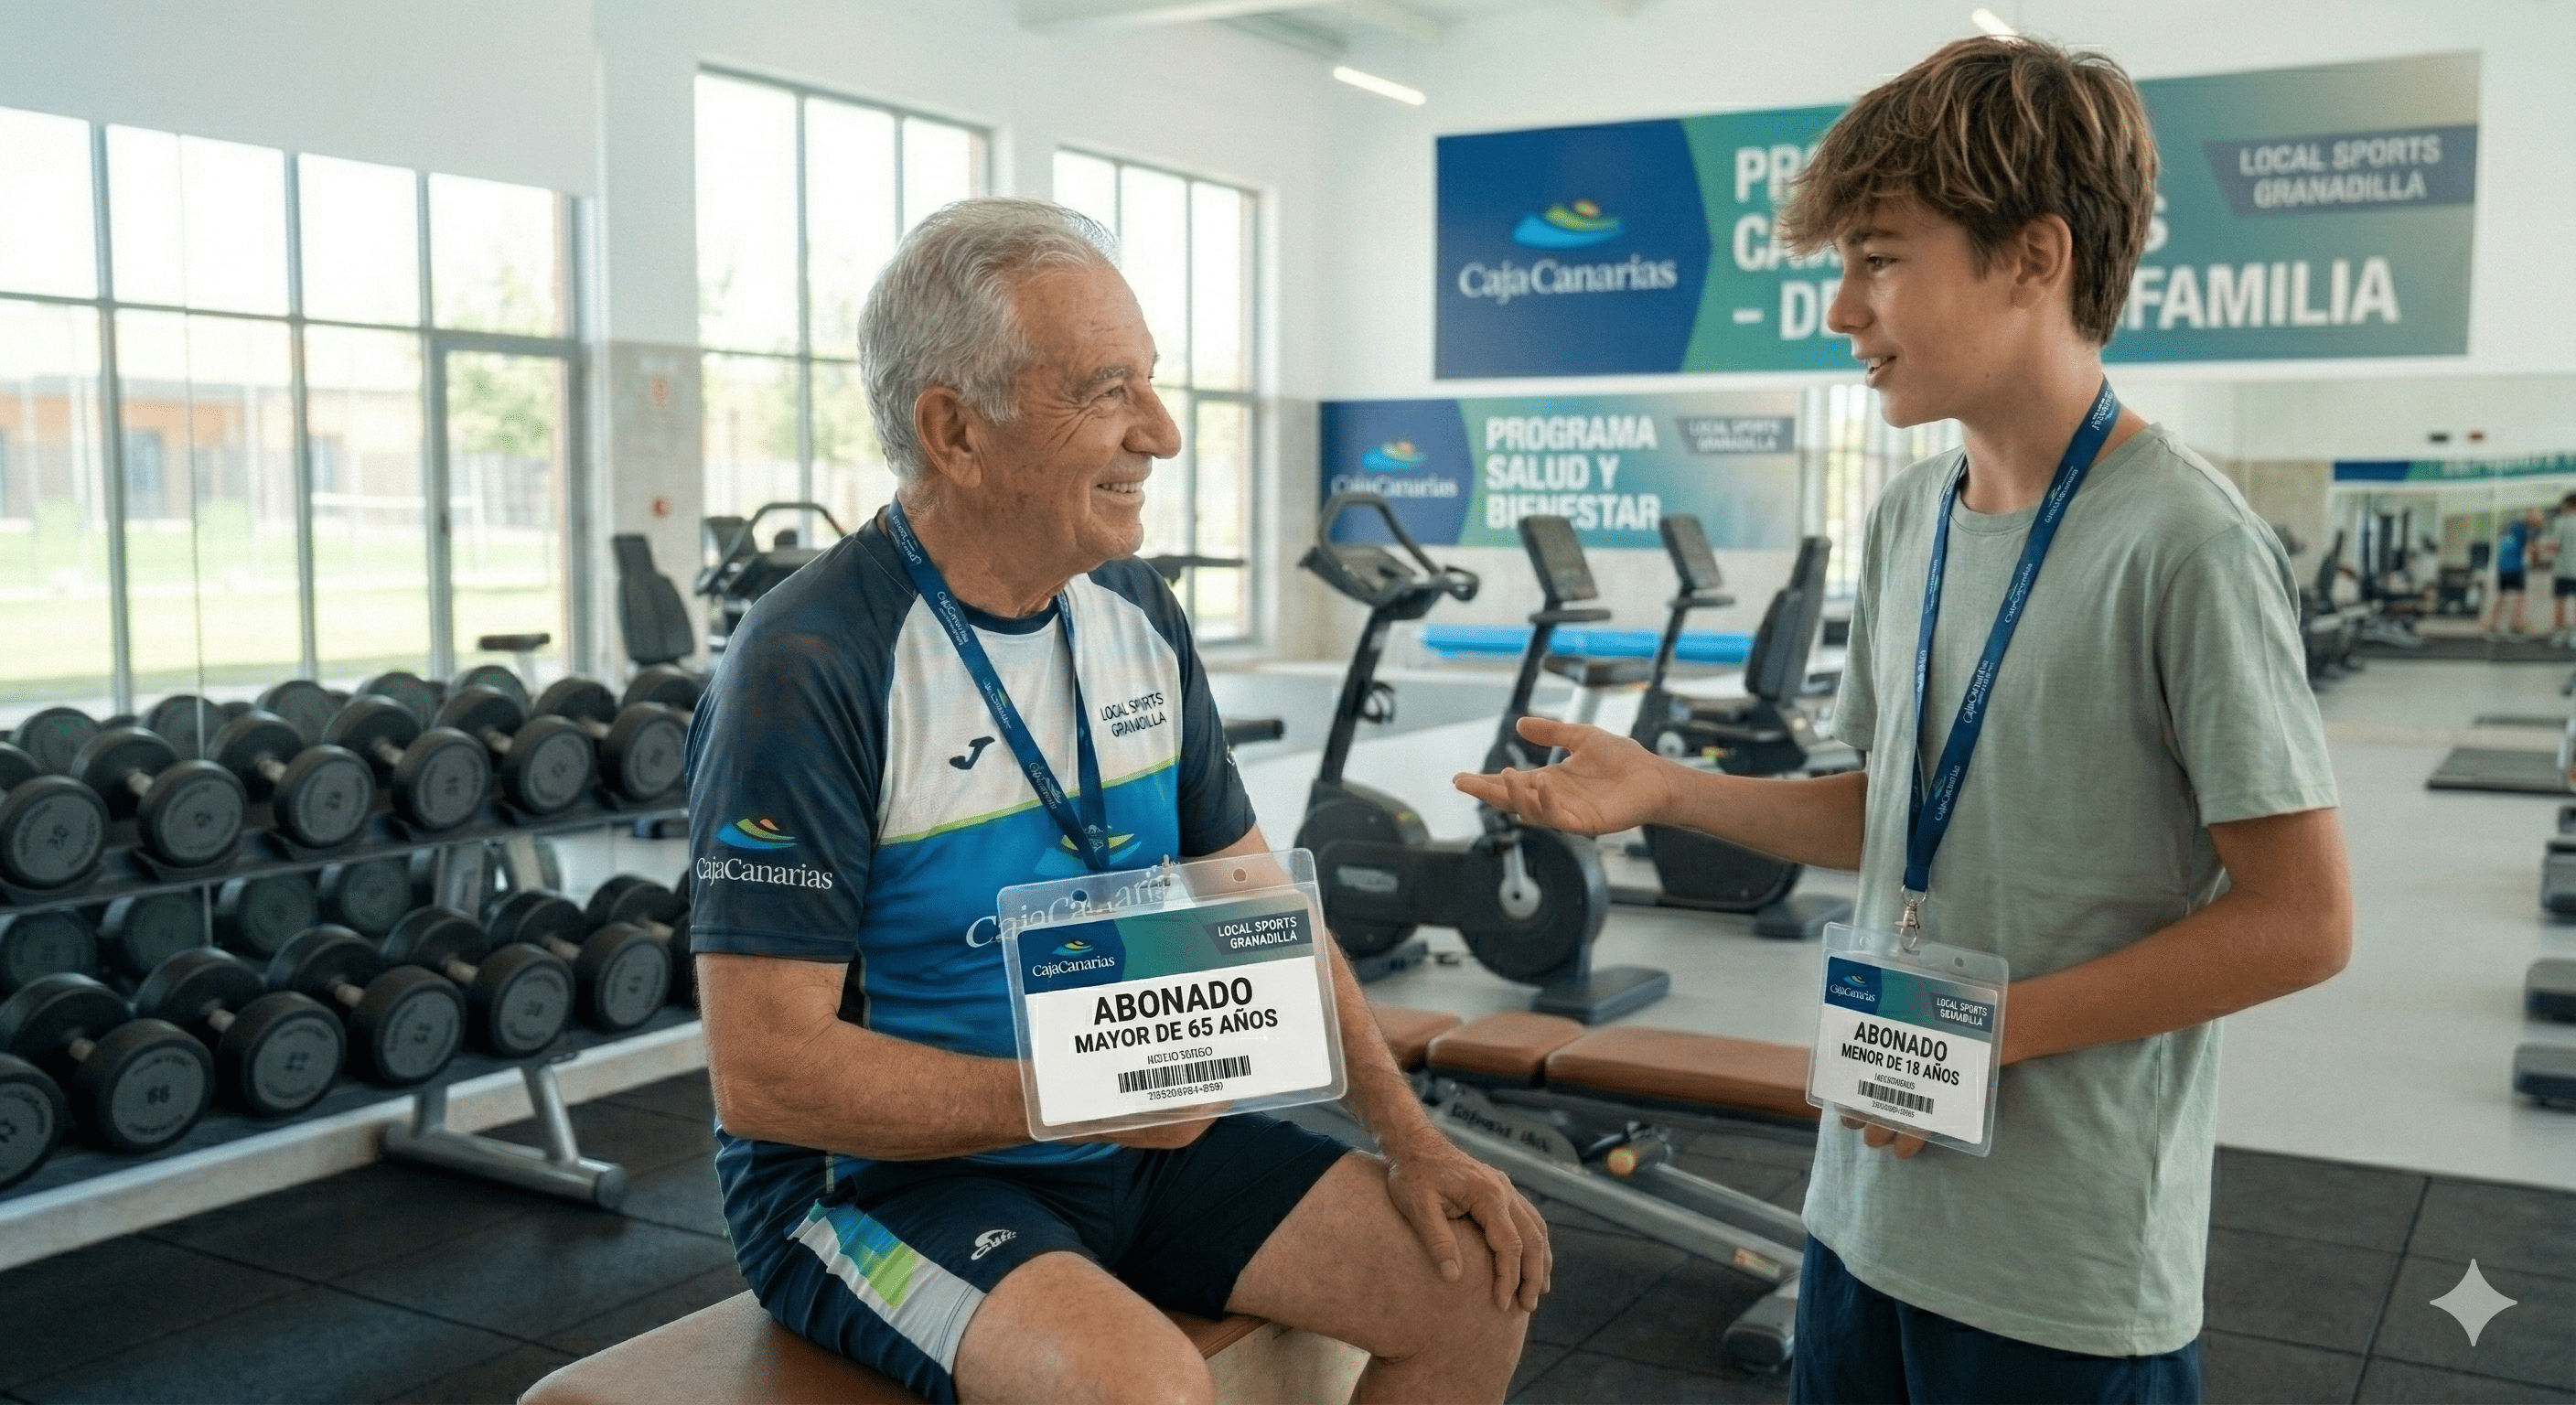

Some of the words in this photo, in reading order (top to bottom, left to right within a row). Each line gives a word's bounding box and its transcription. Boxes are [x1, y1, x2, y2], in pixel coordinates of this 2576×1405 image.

[2239, 144, 2324, 176] LOCAL
[2333, 134, 2443, 169] SPORTS
[2253, 171, 2427, 209] GRANADILLA
[1459, 254, 1679, 305] CajaCanarias
[2127, 255, 2402, 330] FAMILIA
[1486, 416, 1658, 451] PROGRAMA
[1486, 455, 1590, 489] SALUD
[1594, 454, 1620, 489] Y
[1486, 493, 1661, 531] BIENESTAR
[1100, 702, 1129, 721] LOCAL
[696, 855, 833, 890] CajaCanarias
[1218, 922, 1252, 938] LOCAL
[1255, 917, 1297, 932] SPORTS
[1229, 929, 1298, 949] GRANADILLA
[1032, 955, 1115, 979] CajaCanarias
[1093, 977, 1253, 1025] ABONADO
[1937, 997, 1959, 1011] LOCAL
[1959, 1003, 1988, 1017] SPORTS
[1074, 1026, 1151, 1054] MAYOR
[1155, 1022, 1184, 1043] DE
[1187, 1017, 1214, 1038] 65
[1219, 1007, 1278, 1035] AÑOS
[1854, 1022, 1948, 1062] ABONADO
[1841, 1043, 1884, 1067] MENOR
[1886, 1055, 1903, 1071] DE
[1905, 1060, 1921, 1076] 18
[1923, 1062, 1960, 1086] AÑOS
